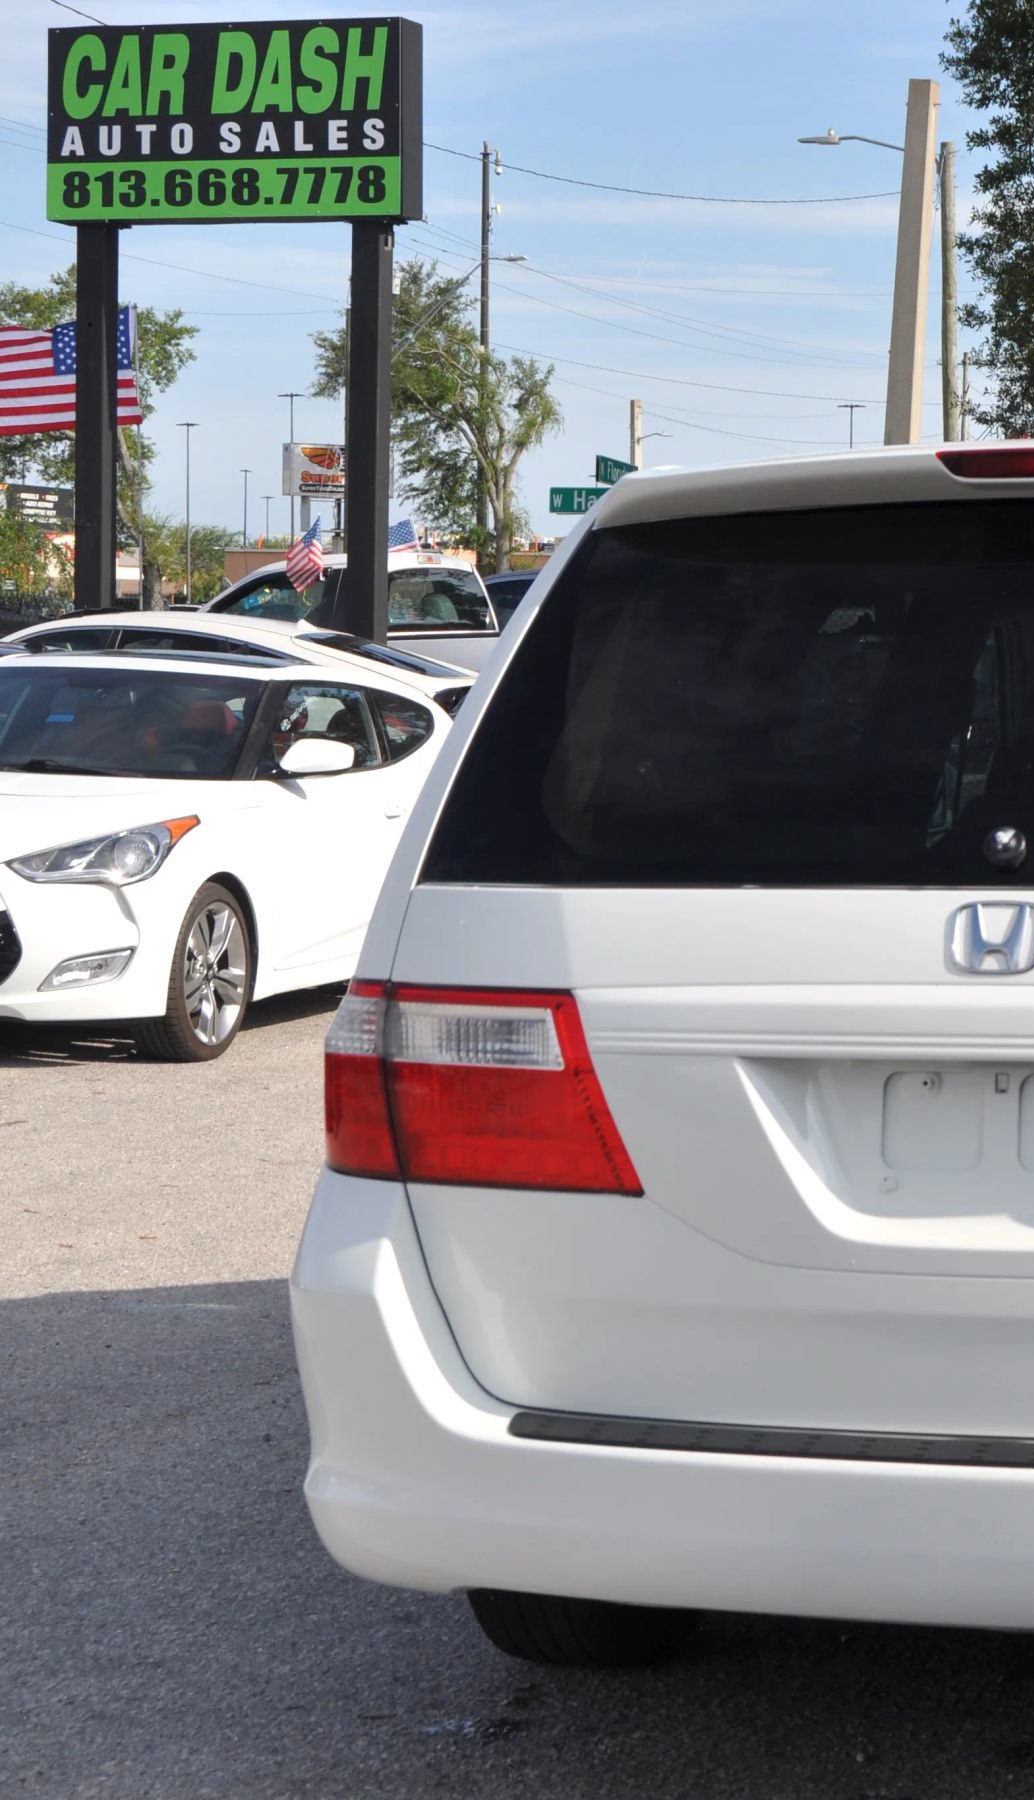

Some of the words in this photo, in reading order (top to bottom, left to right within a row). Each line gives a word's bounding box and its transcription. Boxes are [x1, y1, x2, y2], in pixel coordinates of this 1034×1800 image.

[62, 33, 190, 119] CAR
[210, 26, 389, 115] DASH
[60, 122, 194, 157] AUTO
[219, 118, 385, 153] SALES
[62, 165, 387, 209] 813.668.7778
[552, 493, 564, 508] W
